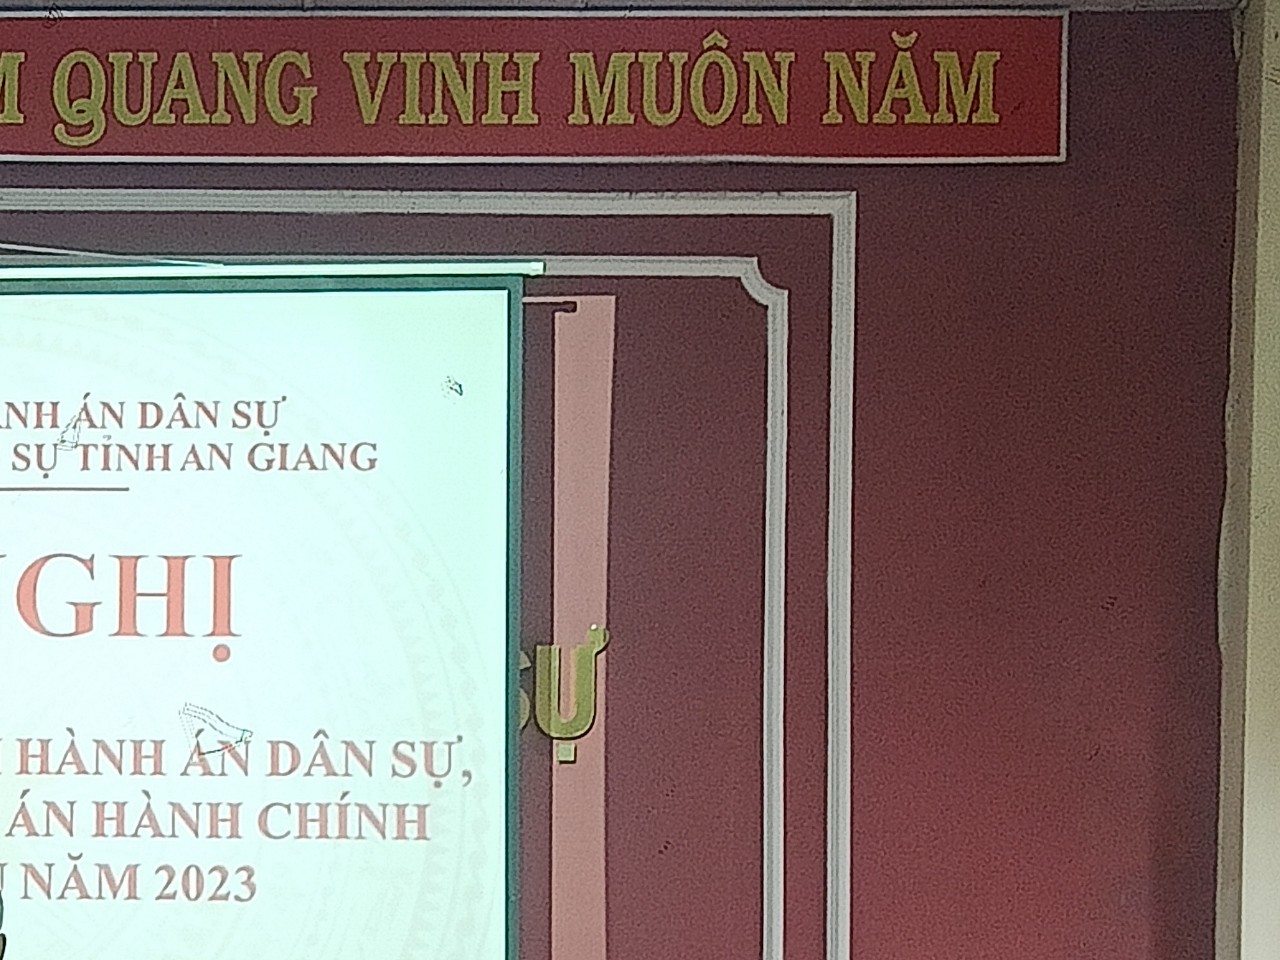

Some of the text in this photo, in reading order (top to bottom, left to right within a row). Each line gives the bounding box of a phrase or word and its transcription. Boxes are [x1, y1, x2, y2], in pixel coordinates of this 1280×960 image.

[53, 51, 318, 147] QUANG
[344, 52, 539, 125] VINH
[569, 33, 794, 126] MUÔN
[823, 34, 1001, 125] NĂM
[73, 391, 126, 430] ÁN
[138, 392, 221, 430] DÂN
[231, 395, 287, 437] SỰ
[11, 440, 61, 479] SỰ
[76, 435, 173, 472] TỈNH
[180, 443, 234, 472] AN
[247, 442, 378, 473] GIANG
[519, 624, 609, 761] Ự
[15, 727, 167, 777] HÀNH
[180, 728, 250, 777] ÁN
[265, 729, 375, 778] DÂN
[391, 735, 473, 789] SỰ,
[5, 789, 76, 838] ÁN
[91, 790, 244, 839] HÀNH
[257, 791, 432, 841] CHÍNH
[20, 852, 141, 901] NĂM
[154, 864, 258, 903] 2023
